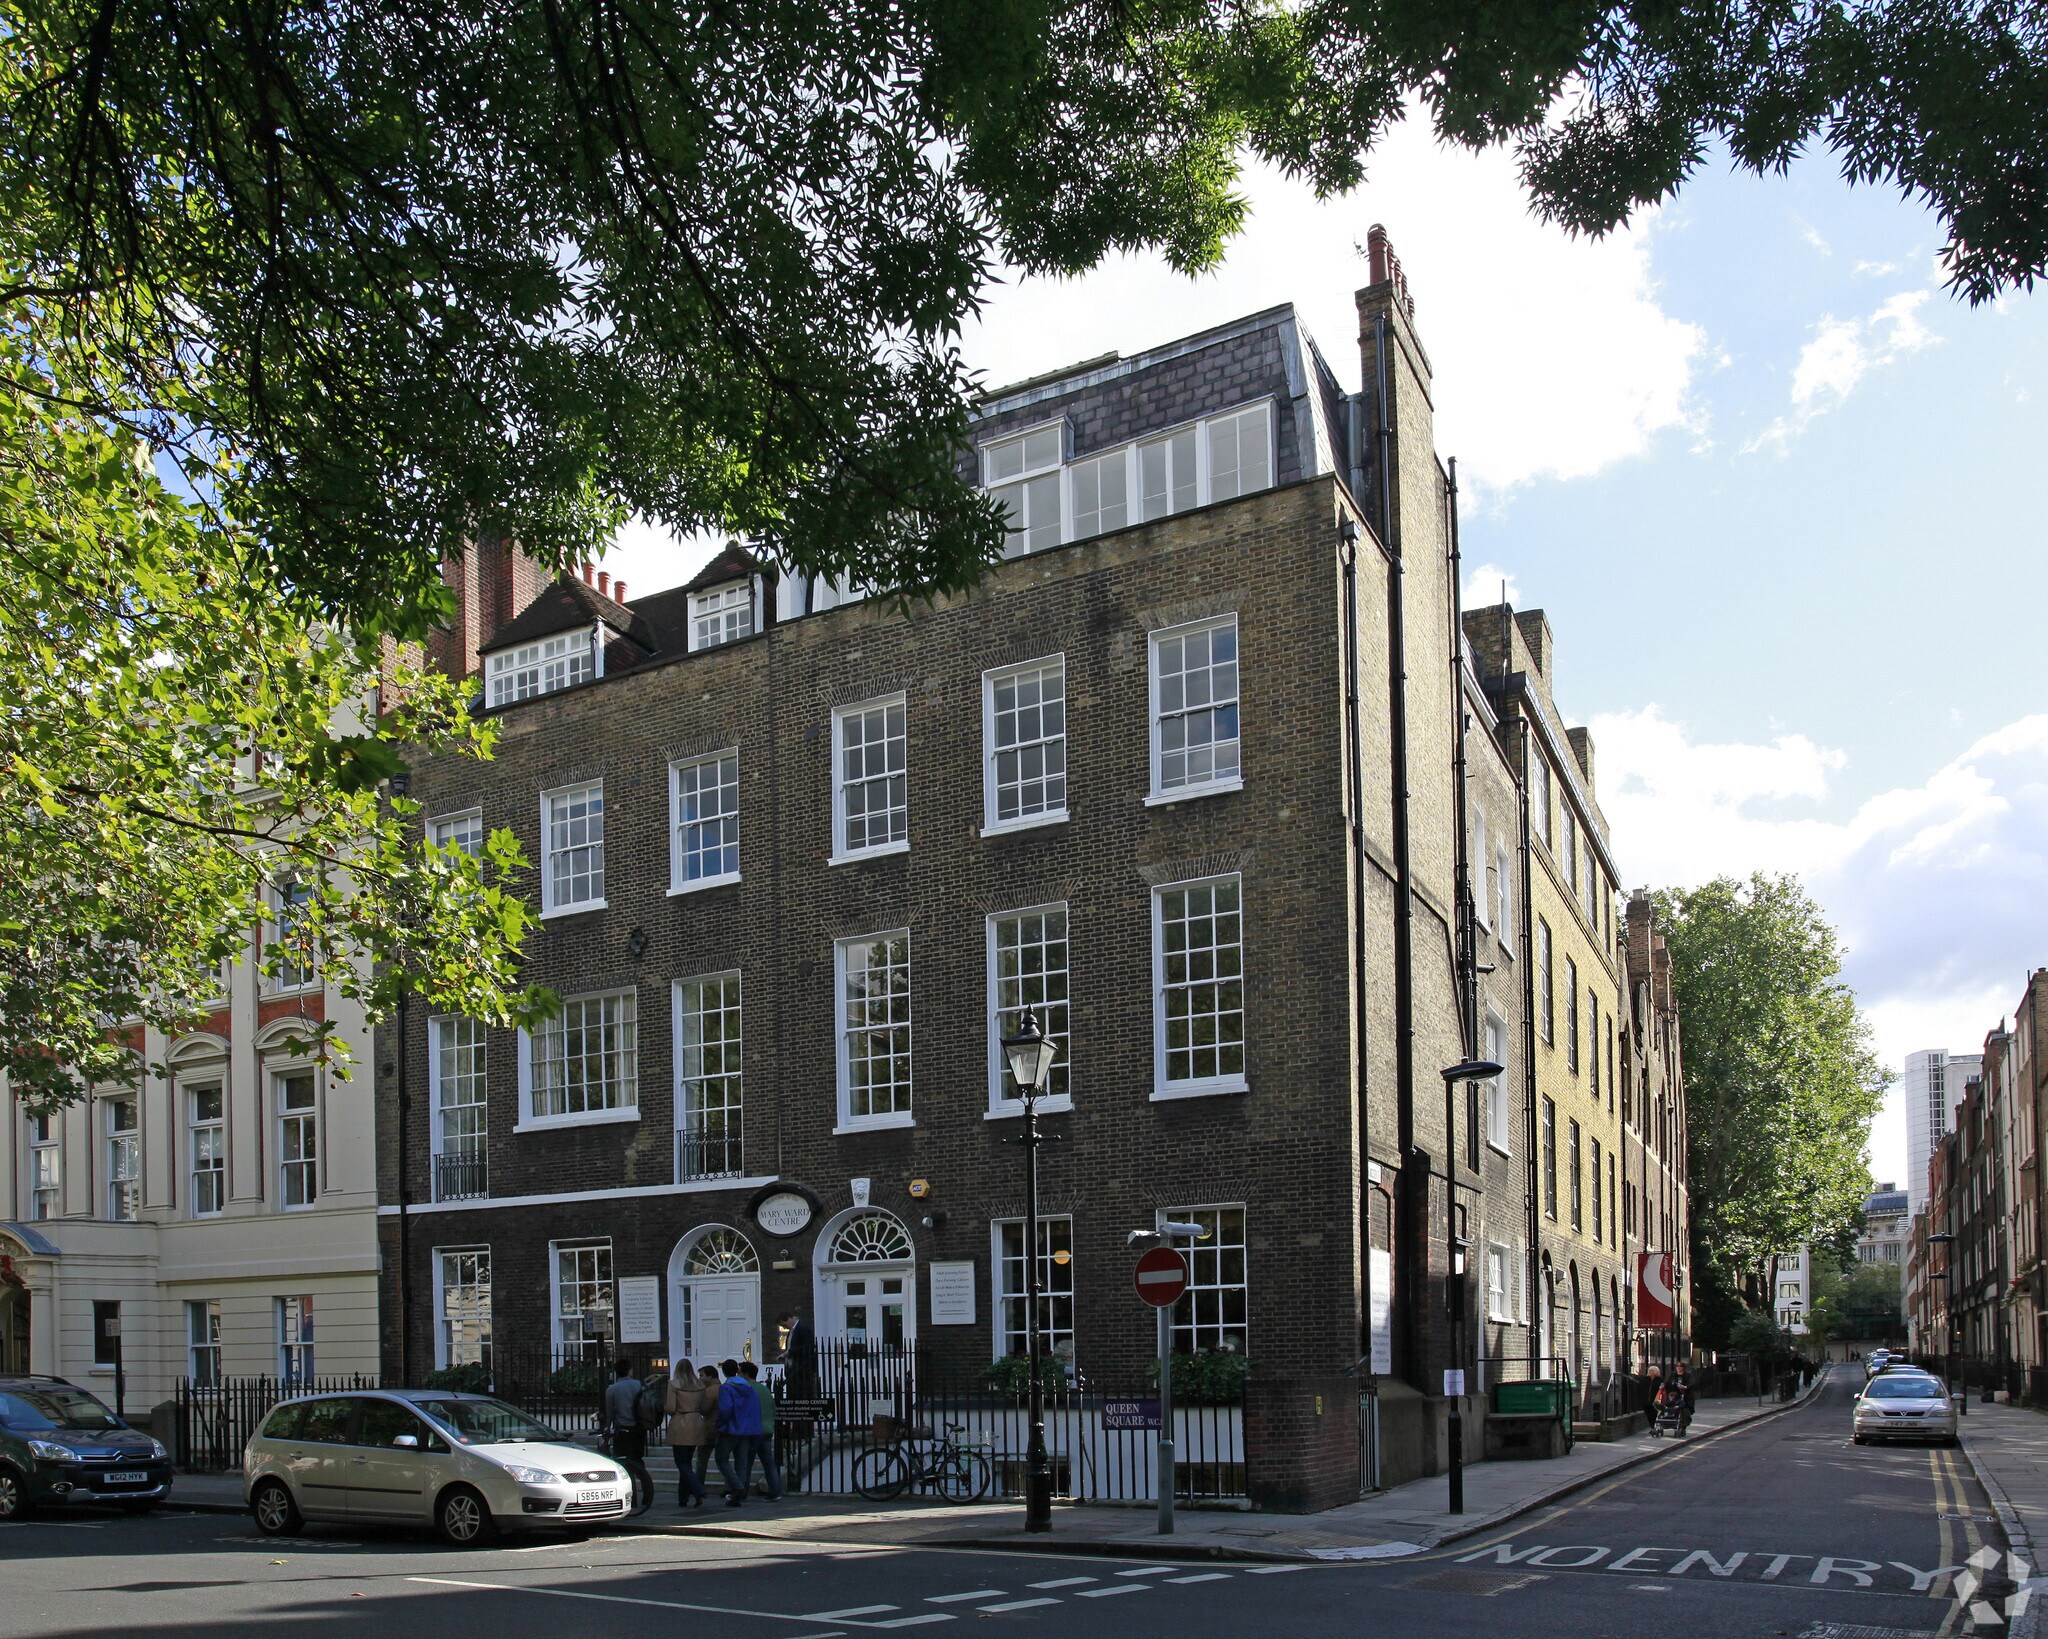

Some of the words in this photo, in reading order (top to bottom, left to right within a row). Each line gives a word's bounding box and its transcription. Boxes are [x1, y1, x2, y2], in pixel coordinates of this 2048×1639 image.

[760, 1210, 780, 1219] MARY
[784, 1208, 810, 1217] WARD
[768, 1217, 801, 1227] CENTRE
[1105, 1403, 1140, 1415] QUEEN
[1106, 1415, 1145, 1428] SQUARE
[128, 1472, 144, 1480] HYK
[581, 1491, 600, 1501] SB56
[600, 1490, 614, 1500] NRF
[1453, 1544, 1610, 1567] NO
[1605, 1547, 1969, 1592] ENTRY
